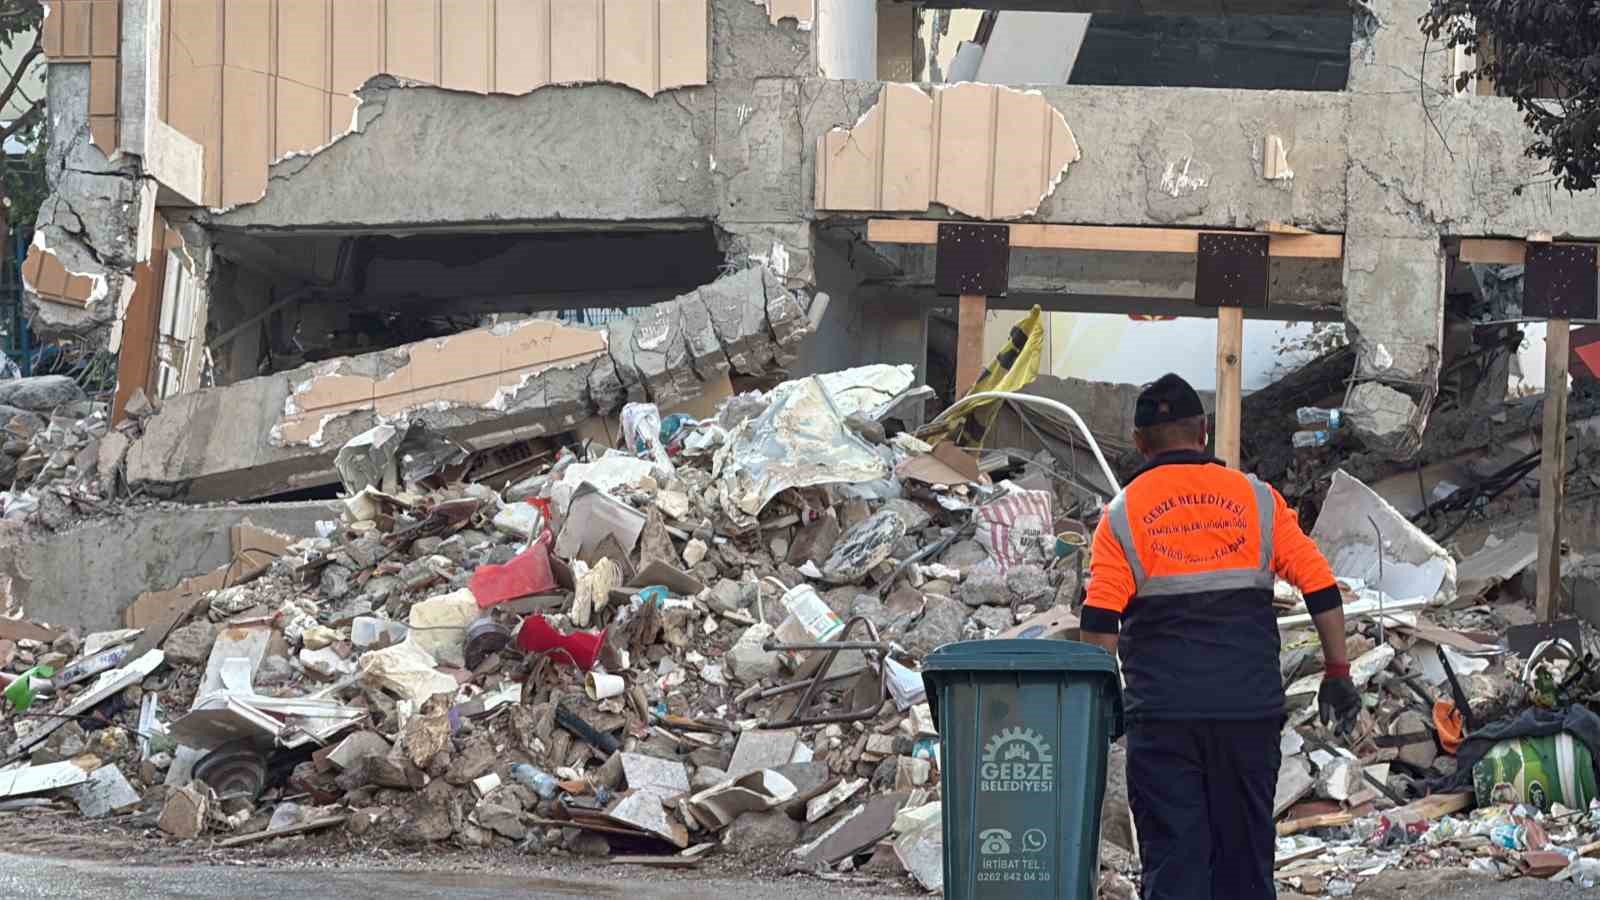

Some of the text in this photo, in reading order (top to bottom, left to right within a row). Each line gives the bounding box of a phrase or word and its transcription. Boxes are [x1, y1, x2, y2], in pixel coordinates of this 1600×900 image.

[1143, 496, 1177, 525] GEBZE
[981, 762, 1054, 780] GEBZE
[980, 780, 1054, 792] BELEDİYESİ
[982, 857, 1019, 870] İRTİBAT
[977, 872, 1001, 881] 0262
[1023, 872, 1037, 881] 04
